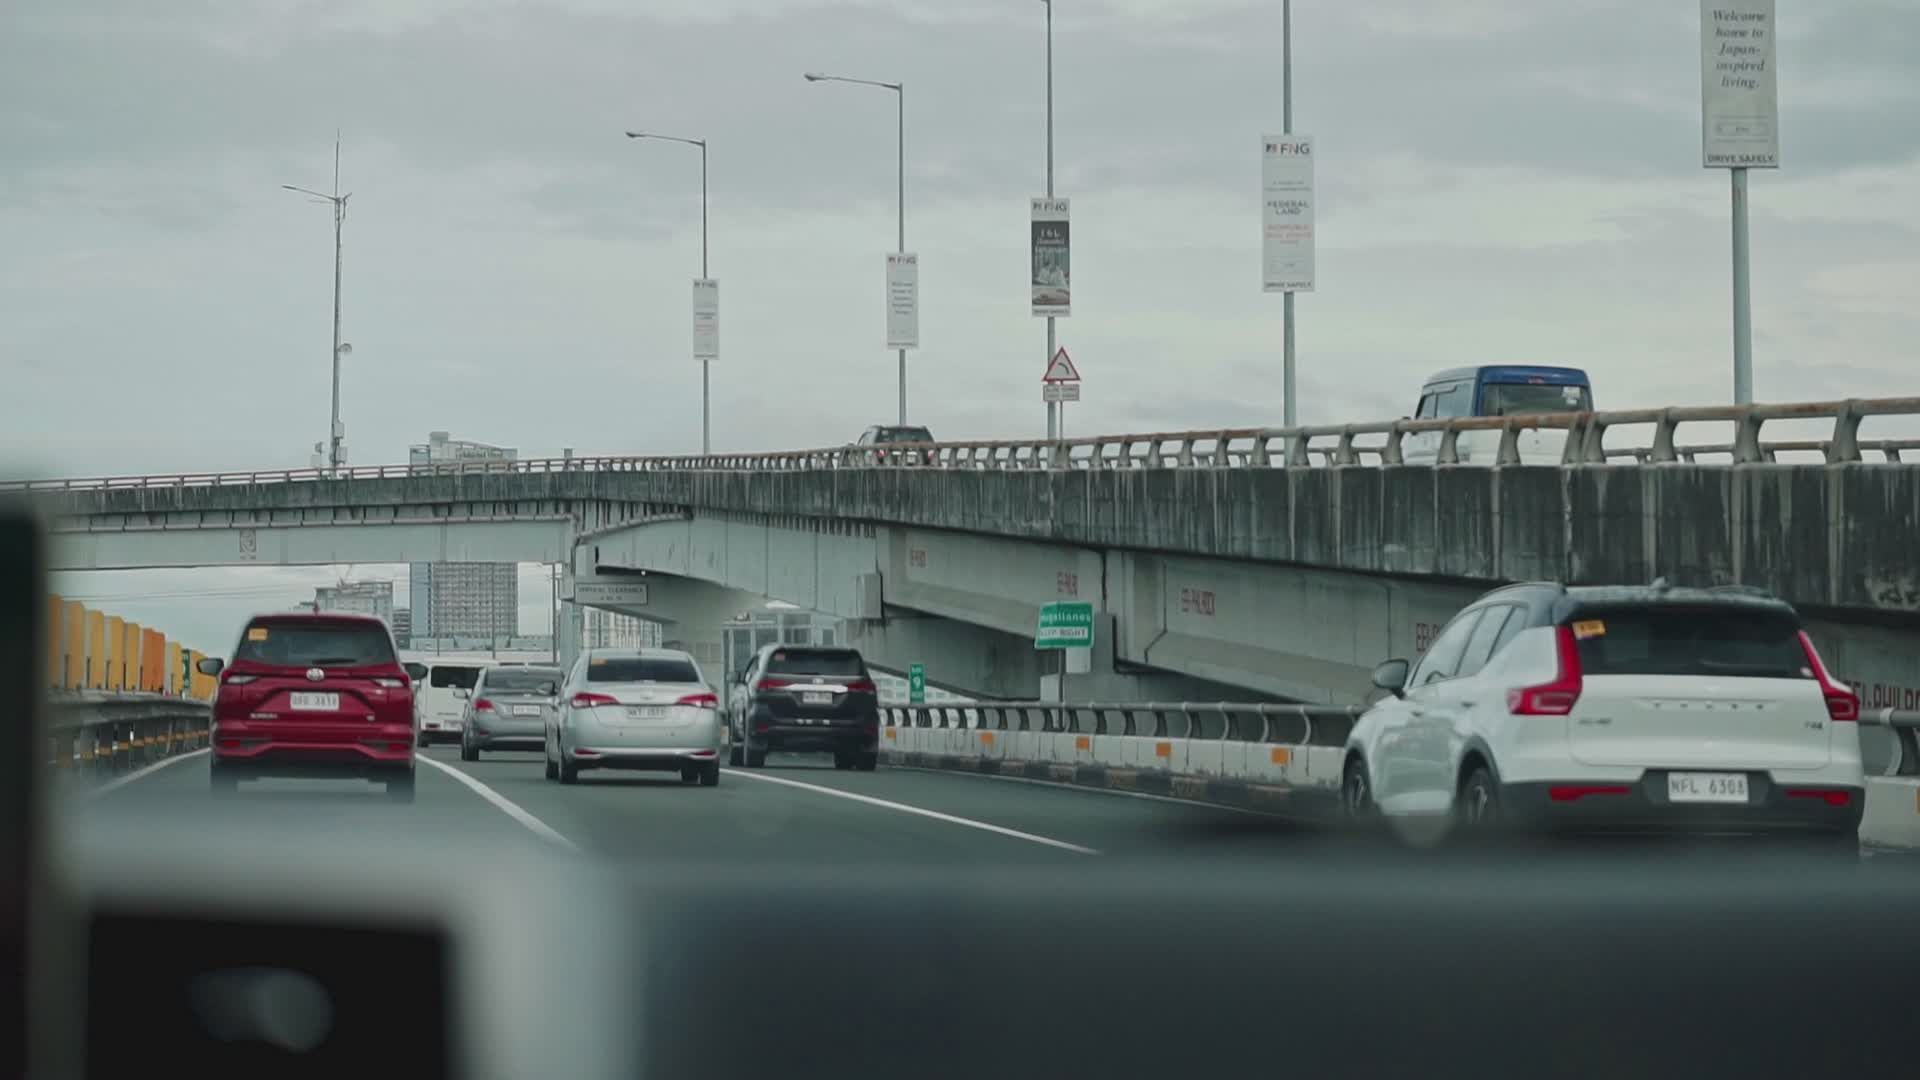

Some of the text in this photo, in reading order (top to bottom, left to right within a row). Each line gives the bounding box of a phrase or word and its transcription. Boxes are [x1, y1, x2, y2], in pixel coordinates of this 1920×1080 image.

[1713, 10, 1766, 22] Welcome
[1715, 26, 1764, 38] home to
[1719, 43, 1761, 57] Japan-
[1715, 58, 1765, 73] inspired
[1280, 143, 1310, 155] FNG
[1707, 154, 1736, 163] DRIVE
